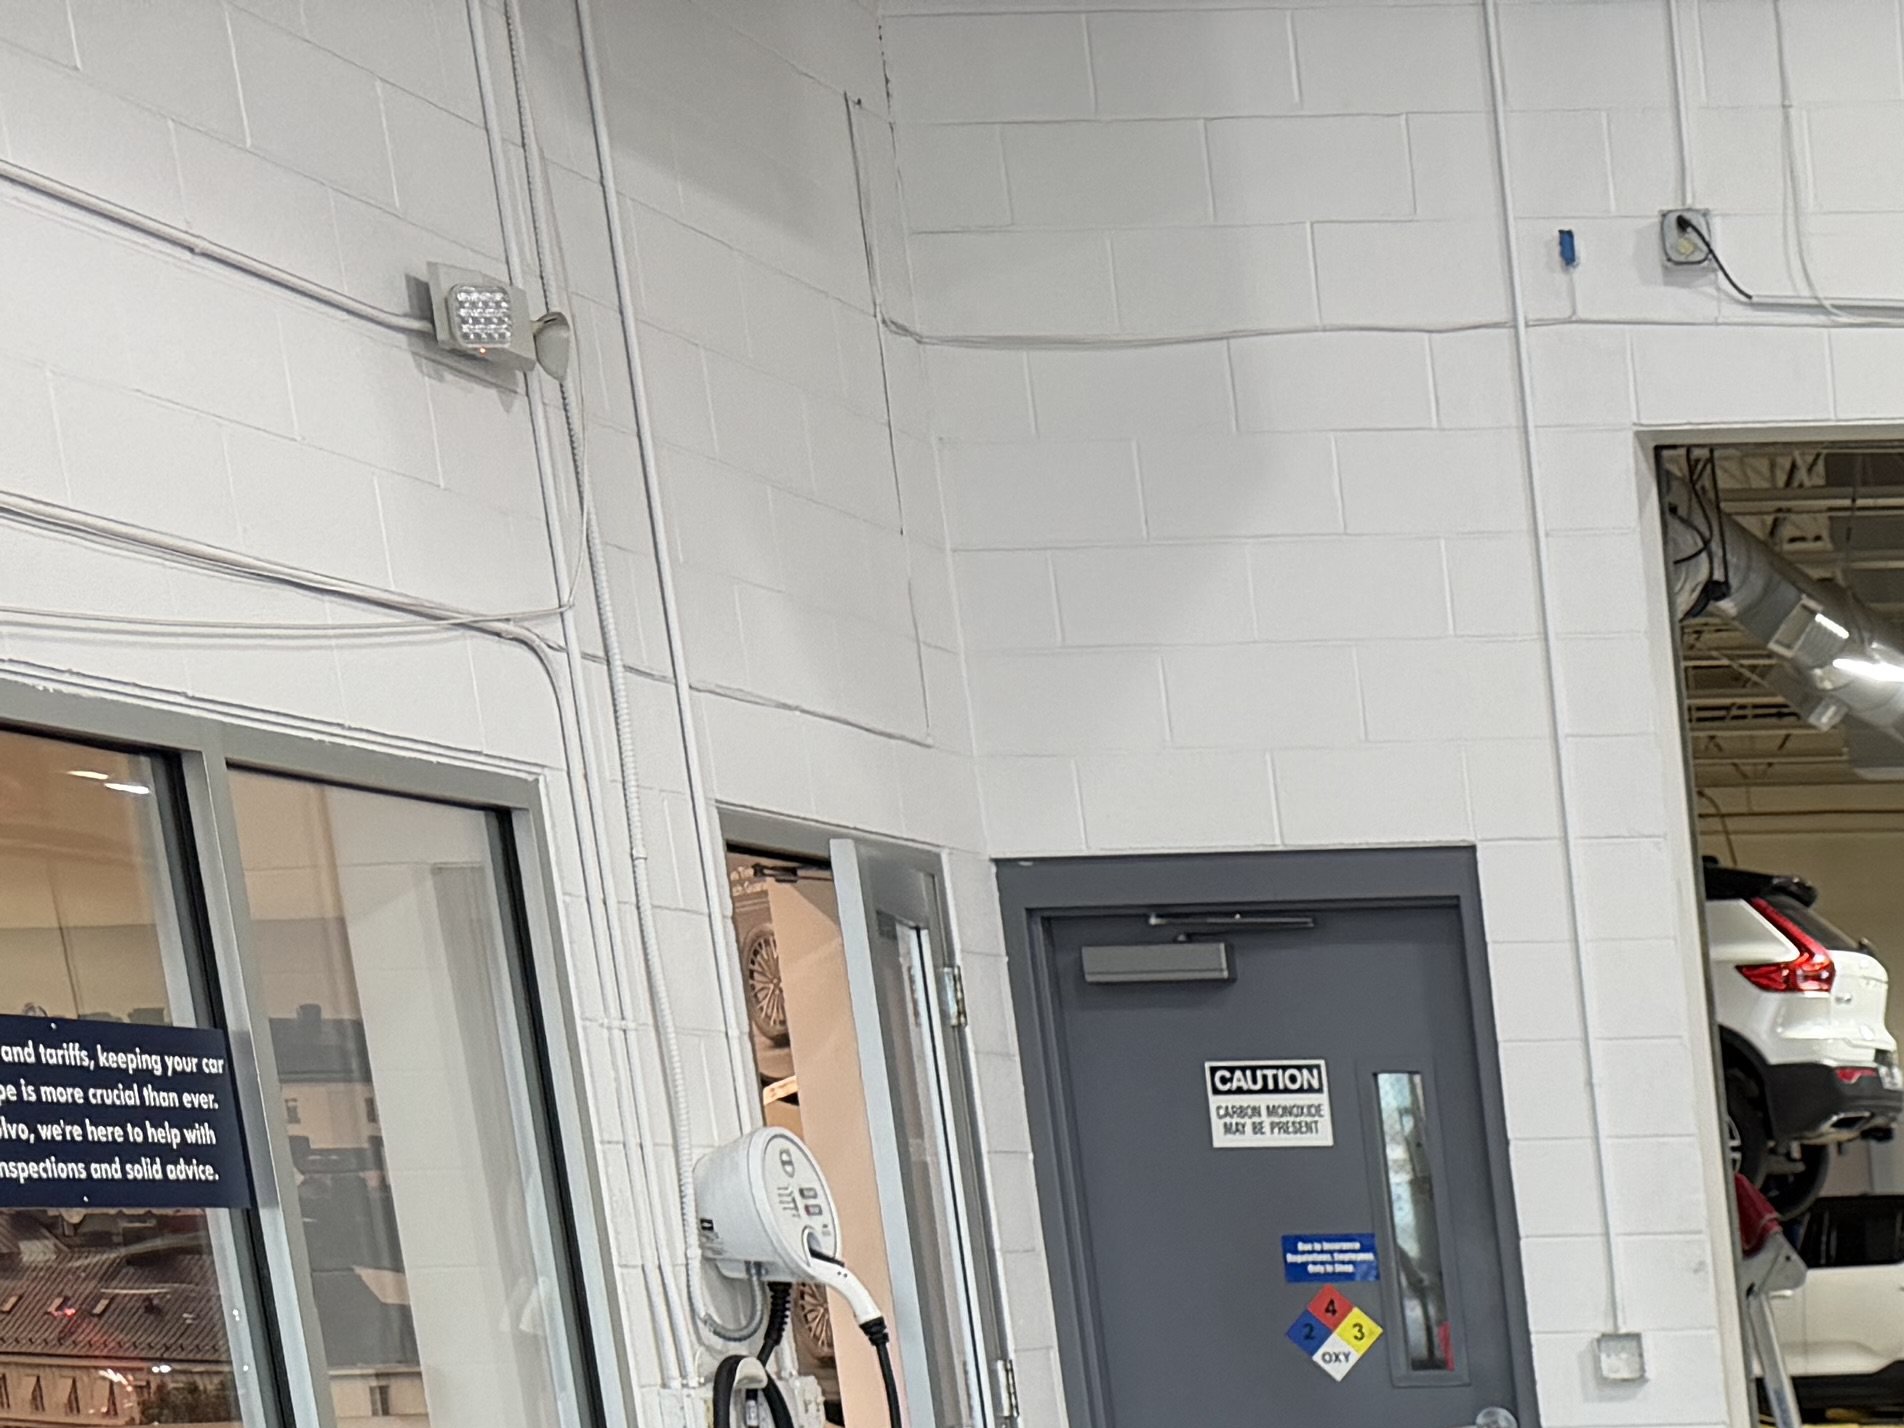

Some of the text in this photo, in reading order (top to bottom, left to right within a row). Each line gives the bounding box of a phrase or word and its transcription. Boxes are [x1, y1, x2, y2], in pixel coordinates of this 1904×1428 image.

[1, 1040, 224, 1076] and tariffs, keeping your car
[1214, 1068, 1320, 1092] CAUTION
[21, 1079, 36, 1101] is
[41, 1086, 83, 1104] more
[89, 1084, 139, 1106] crucial
[143, 1087, 179, 1107] than
[183, 1092, 218, 1109] ever.
[1216, 1104, 1324, 1118] CARBON MONOXIDE
[37, 1121, 82, 1141] we're
[85, 1119, 124, 1142] here
[127, 1123, 143, 1142] to
[148, 1121, 180, 1149] help
[183, 1123, 216, 1145] with
[1224, 1120, 1319, 1135] MAY BE PRESENT
[91, 1157, 122, 1180] and
[127, 1157, 163, 1180] solid
[166, 1159, 219, 1181] advice.
[1325, 1299, 1337, 1318] 4
[1304, 1324, 1364, 1342] 2 3
[1322, 1351, 1351, 1364] OXY
